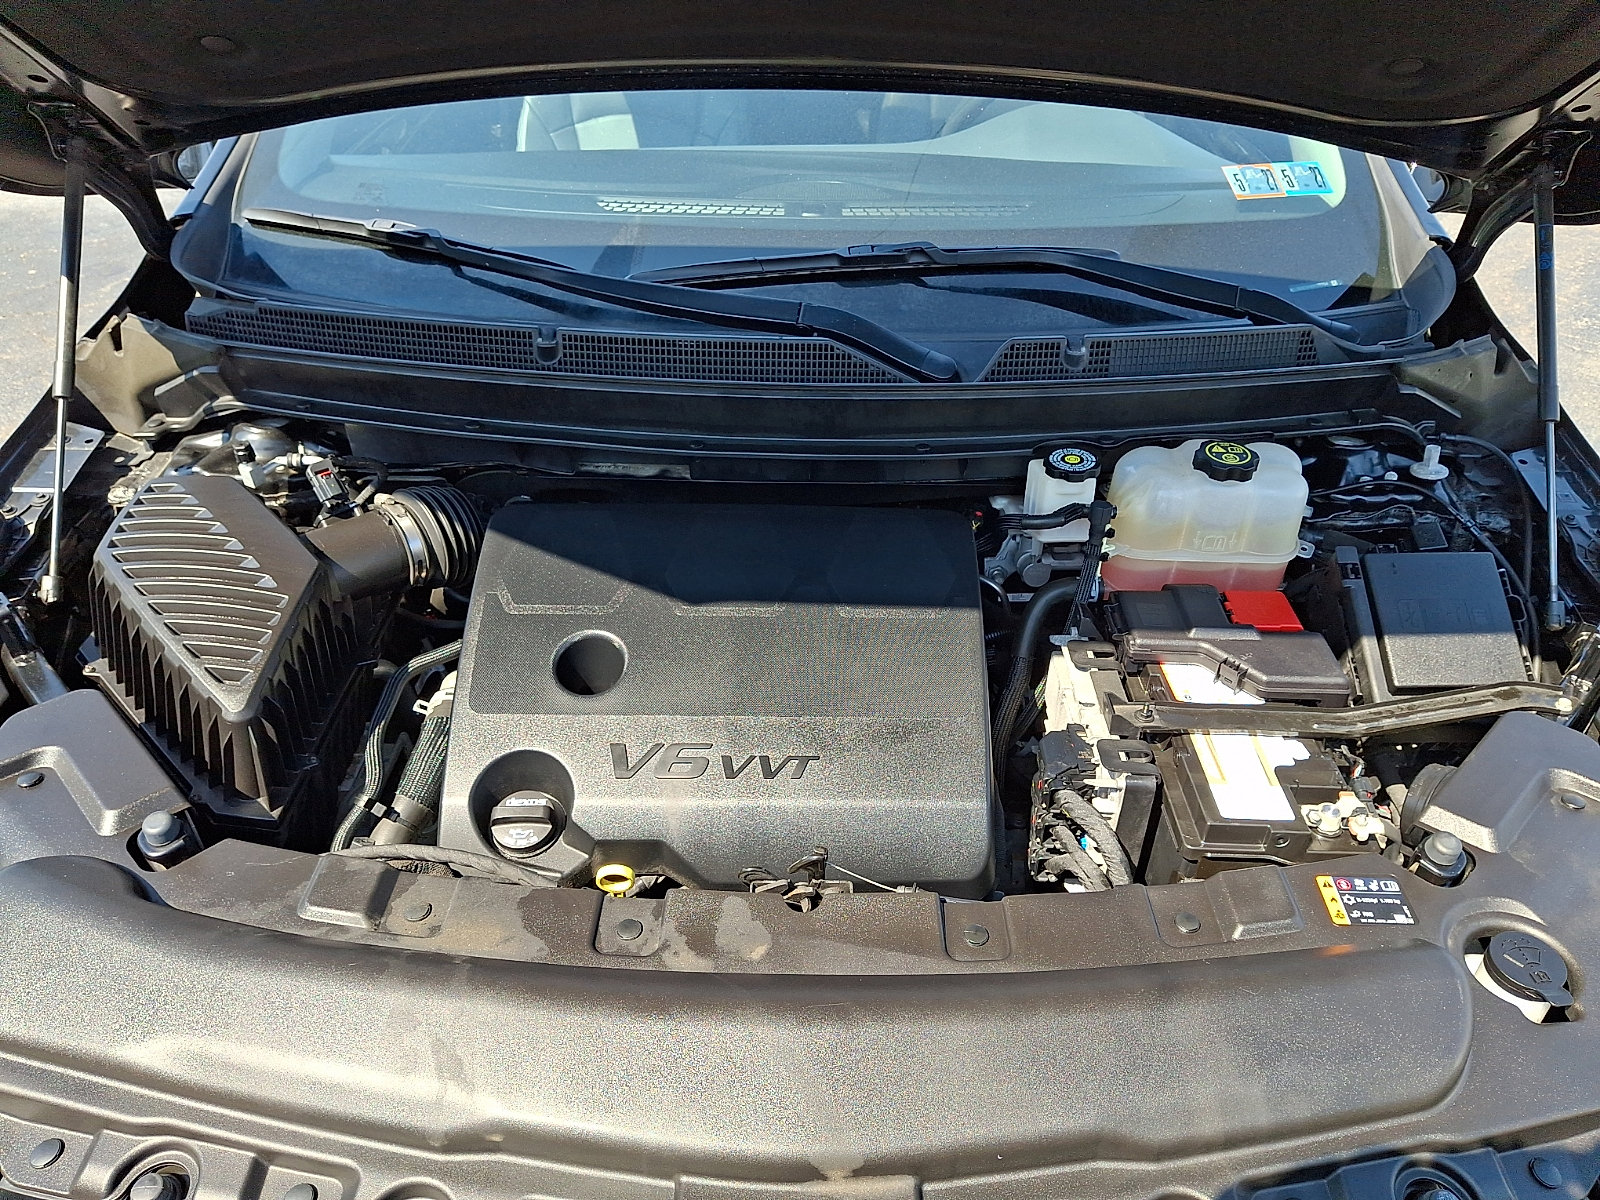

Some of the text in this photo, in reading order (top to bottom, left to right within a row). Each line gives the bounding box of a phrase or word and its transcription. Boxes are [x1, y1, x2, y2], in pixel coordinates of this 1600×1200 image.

[1233, 168, 1279, 192] 5 27
[1281, 166, 1327, 189] 5 27
[610, 743, 821, 780] V6 VVT
